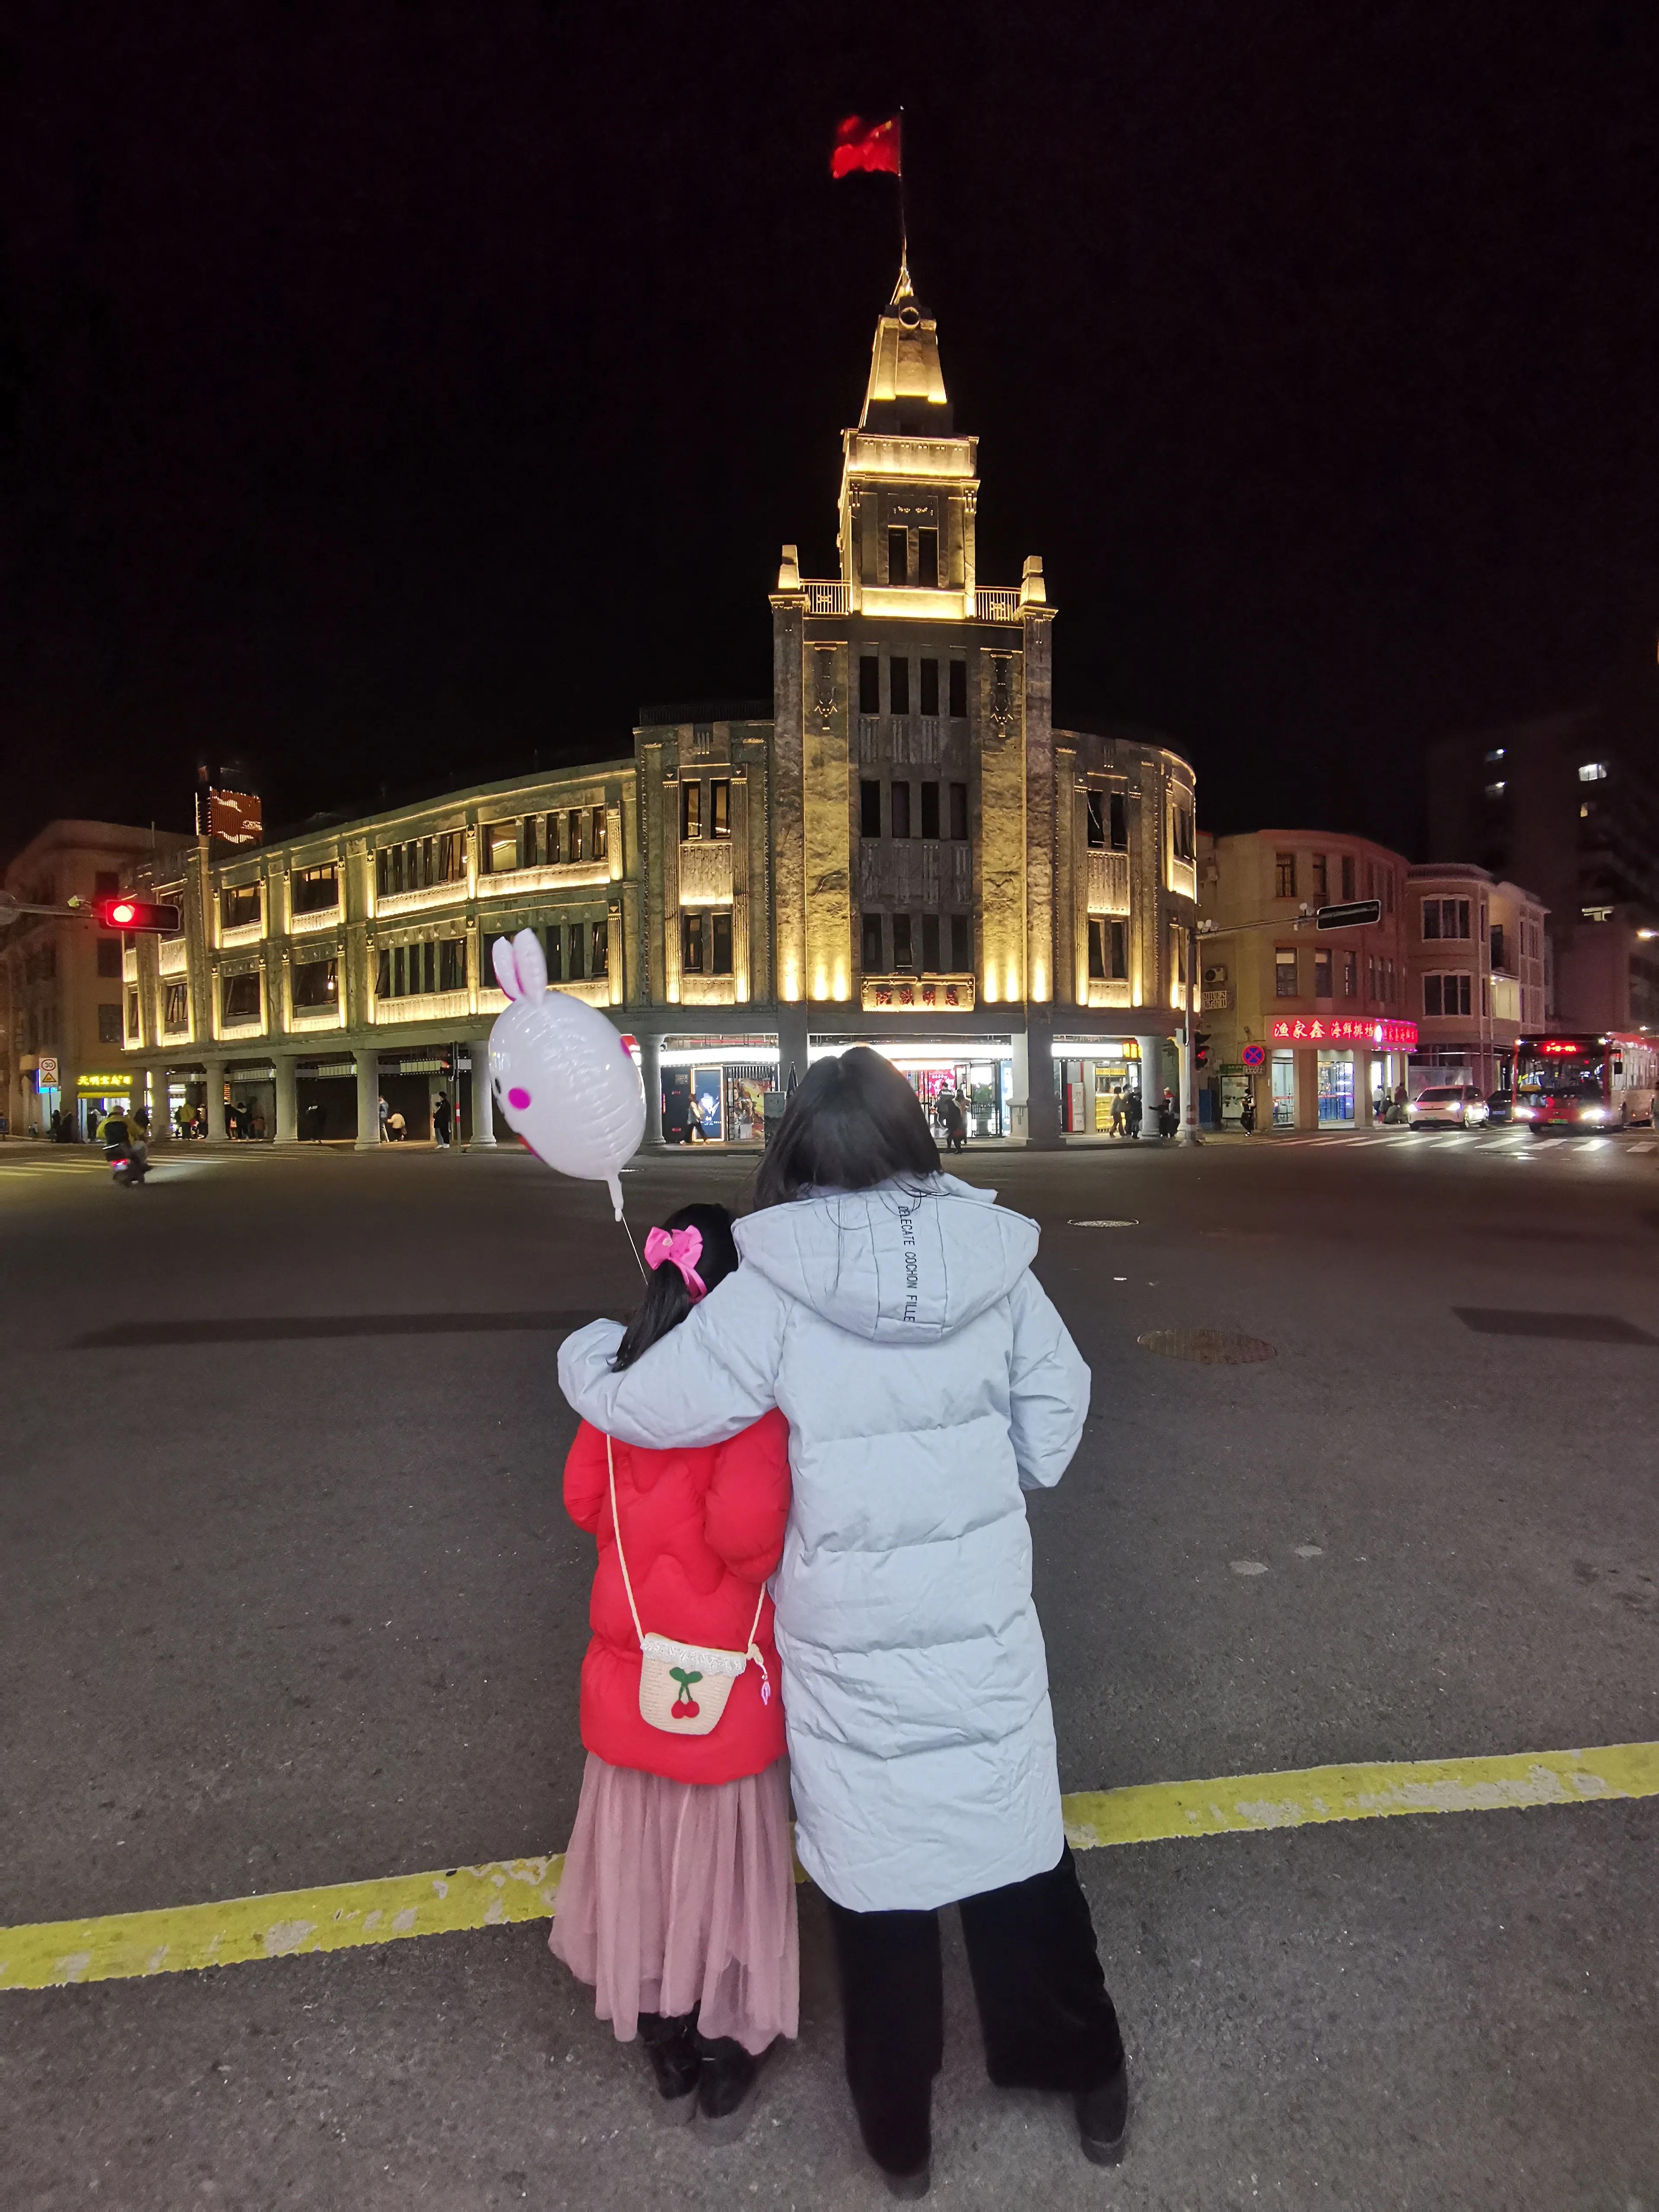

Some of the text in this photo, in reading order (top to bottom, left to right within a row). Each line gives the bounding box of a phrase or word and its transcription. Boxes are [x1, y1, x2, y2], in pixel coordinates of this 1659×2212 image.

[1274, 1019, 1374, 1039] 渔家鑫 海鲜排档
[905, 1252, 918, 1288] COCHON
[904, 1295, 917, 1322] FILLE
